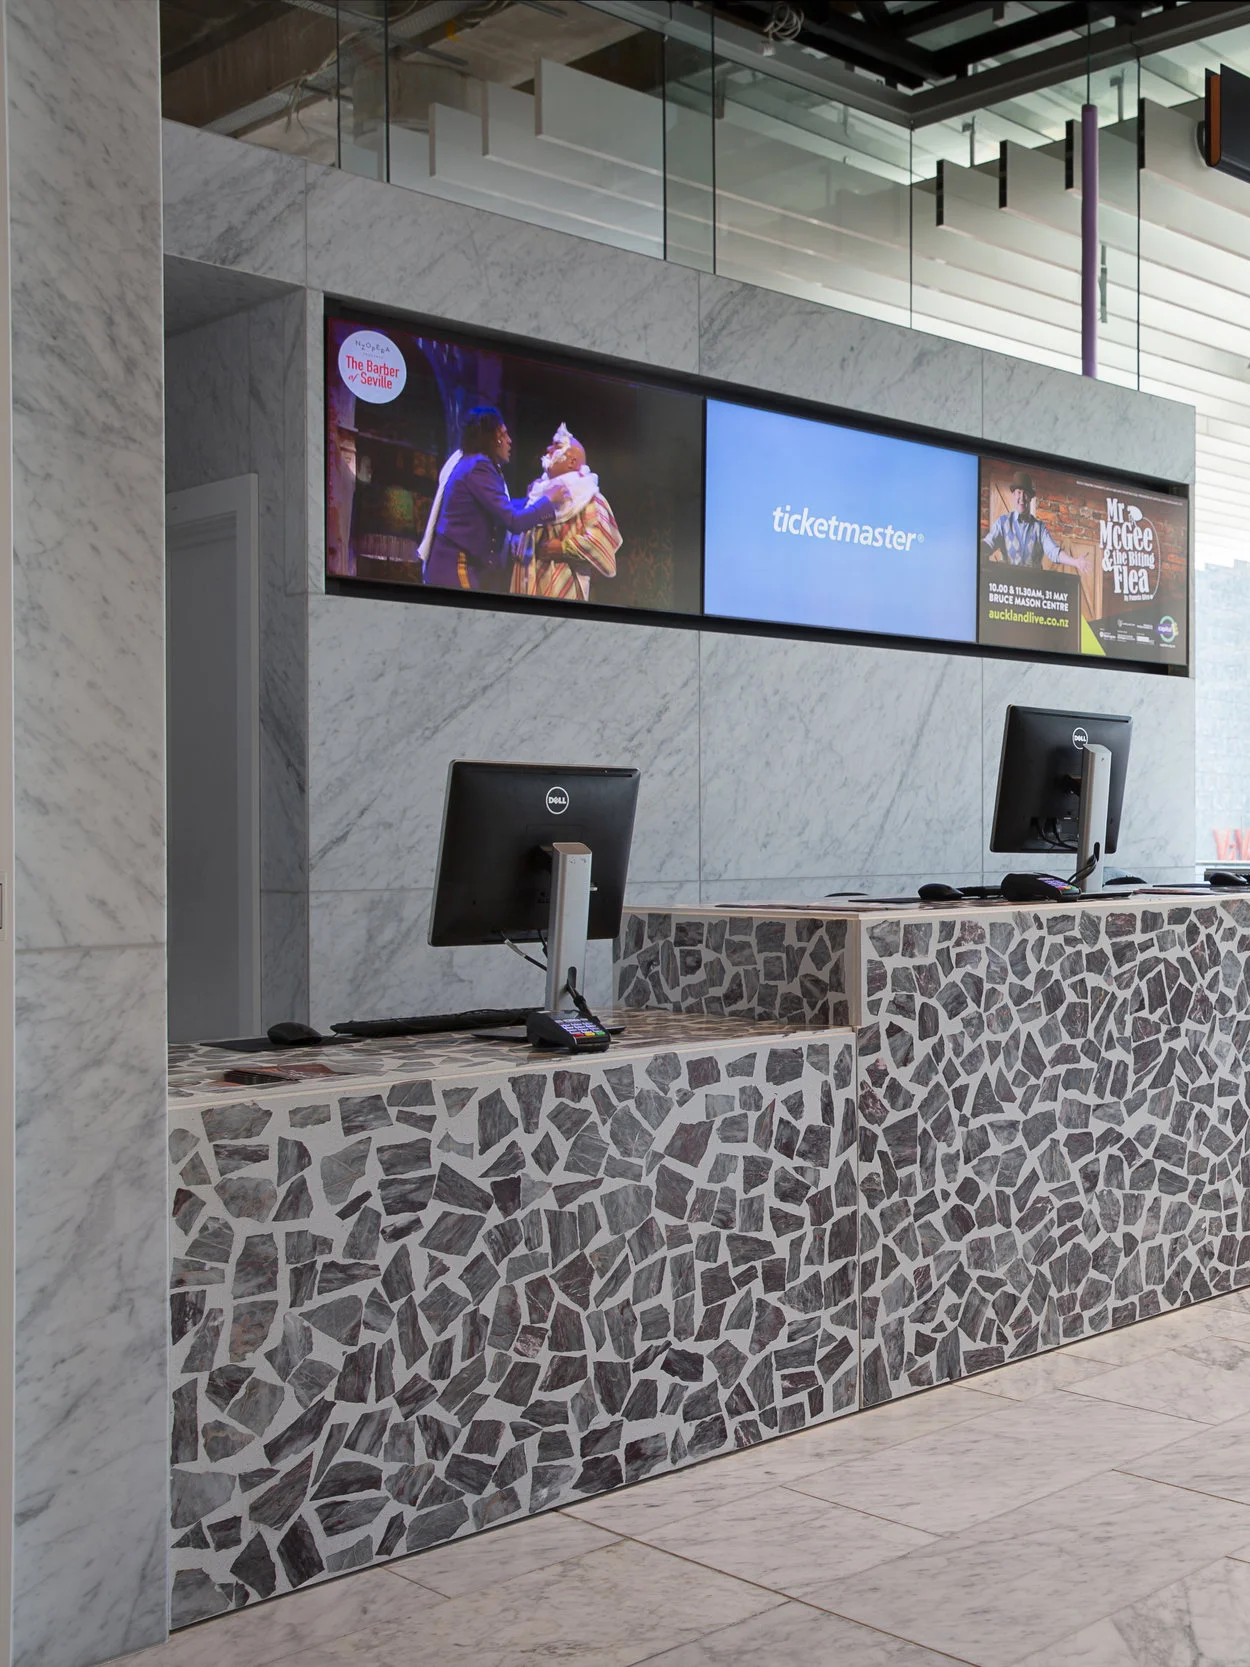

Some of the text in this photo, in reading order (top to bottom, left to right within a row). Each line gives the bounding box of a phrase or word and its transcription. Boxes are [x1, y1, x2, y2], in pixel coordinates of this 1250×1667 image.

[345, 355, 400, 379] The Barber
[360, 371, 393, 389] Seville
[1106, 497, 1125, 523] Mr
[772, 505, 917, 552] ticketmaster
[1099, 519, 1153, 552] McGee
[1101, 548, 1114, 572] &
[1112, 549, 1128, 566] the
[1113, 564, 1150, 594] Flea
[988, 582, 1009, 594] 10.00
[1009, 585, 1015, 595] &
[1045, 590, 1052, 600] 31
[1053, 591, 1069, 601] MAY
[988, 592, 1069, 612] BRUCE MASON CENTRE
[988, 608, 1070, 628] aucklandlive.co.nz
